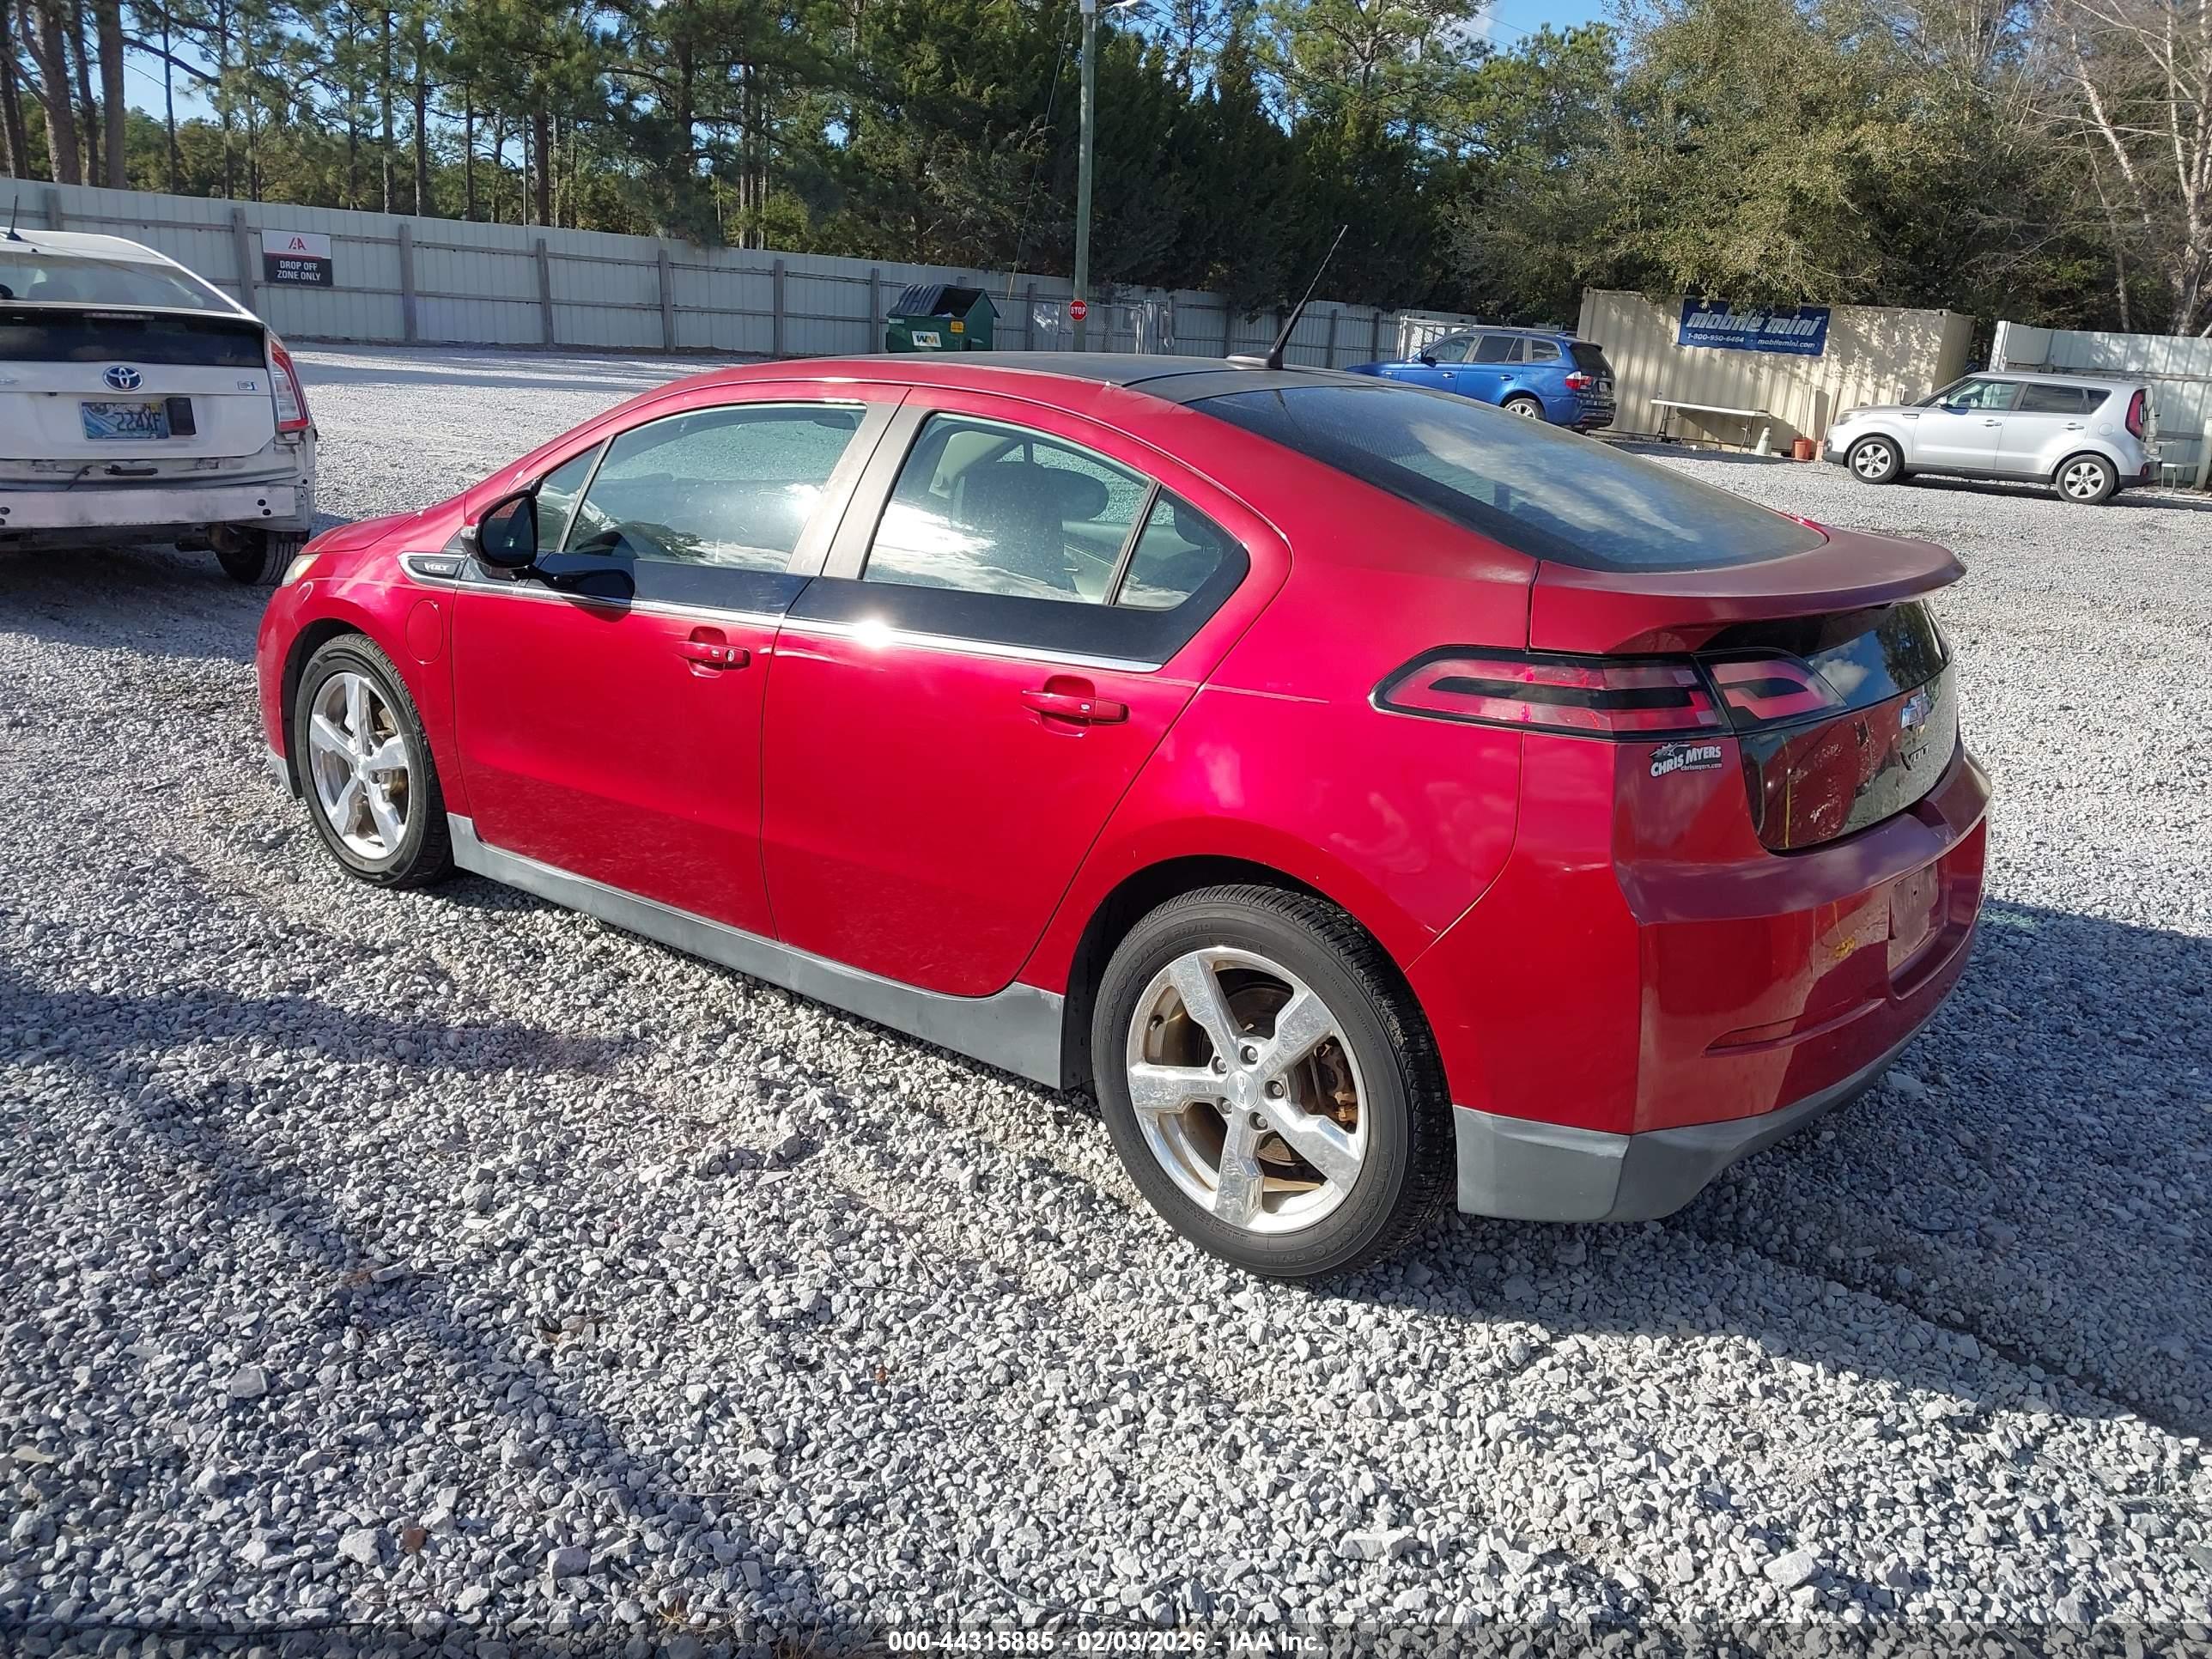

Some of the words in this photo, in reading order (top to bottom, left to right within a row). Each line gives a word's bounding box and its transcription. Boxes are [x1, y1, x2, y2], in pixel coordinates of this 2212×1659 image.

[280, 261, 301, 270] DROP
[304, 263, 318, 271] OFF
[277, 270, 299, 279] ZONE
[301, 272, 321, 281] ONLY
[1071, 307, 1086, 315] STOP
[1686, 307, 1764, 332] mobile
[1765, 315, 1820, 336] mini
[916, 335, 938, 343] WM
[1650, 754, 1684, 777] CHRIS
[1686, 745, 1722, 764] MYERS
